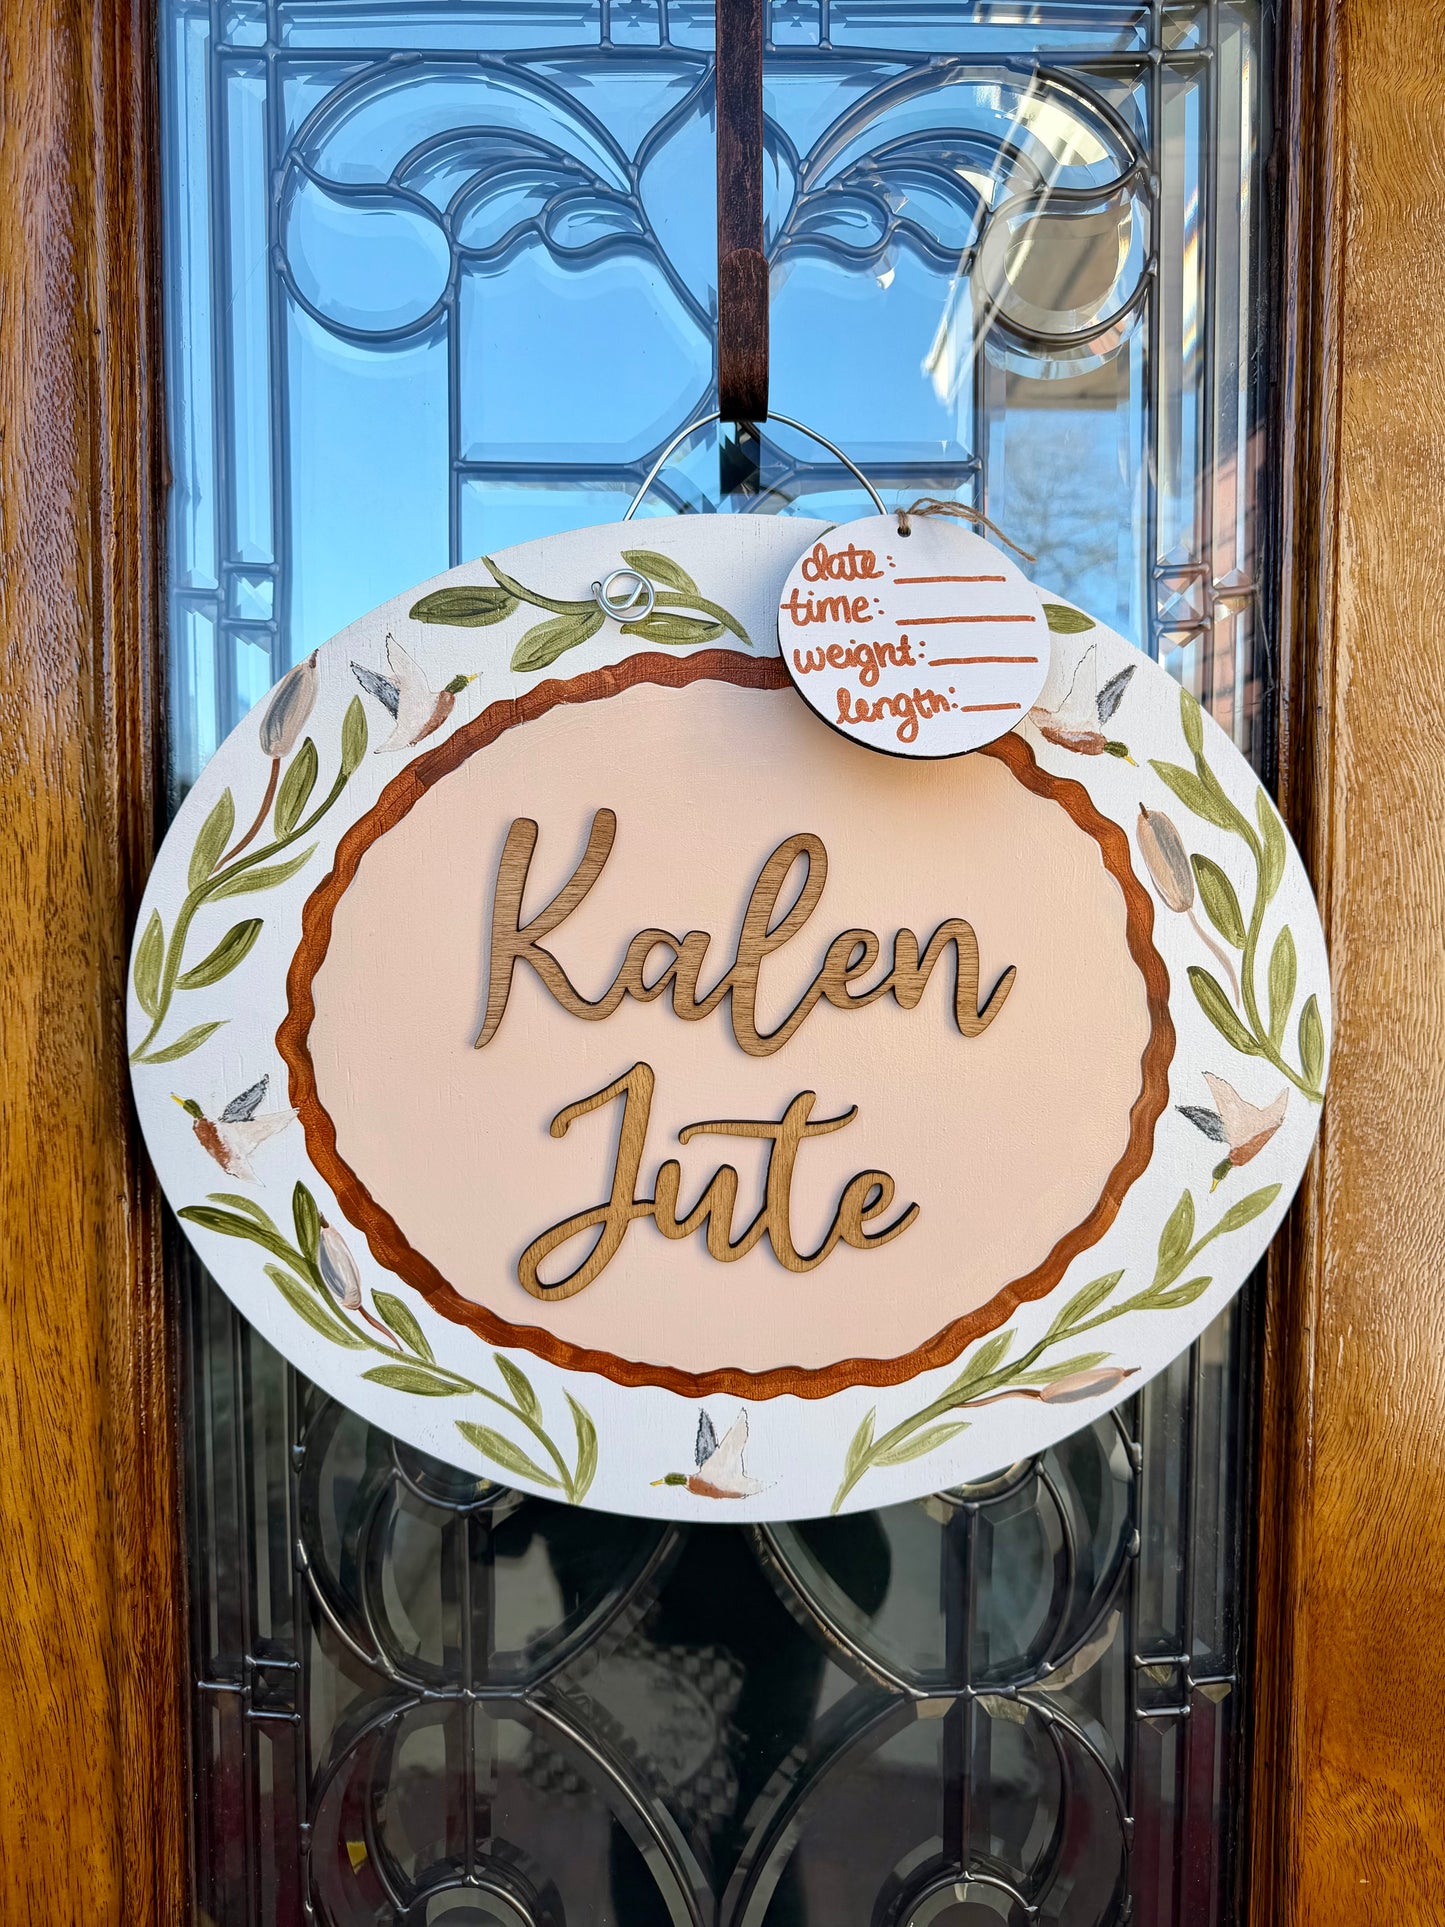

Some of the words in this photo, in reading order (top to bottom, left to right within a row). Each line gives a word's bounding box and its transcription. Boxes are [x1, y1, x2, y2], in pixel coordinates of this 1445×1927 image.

[801, 543, 896, 582] date:
[780, 588, 884, 626] time:
[836, 686, 959, 743] length:
[474, 807, 1017, 1058] Kalen
[517, 1061, 920, 1301] Jute
